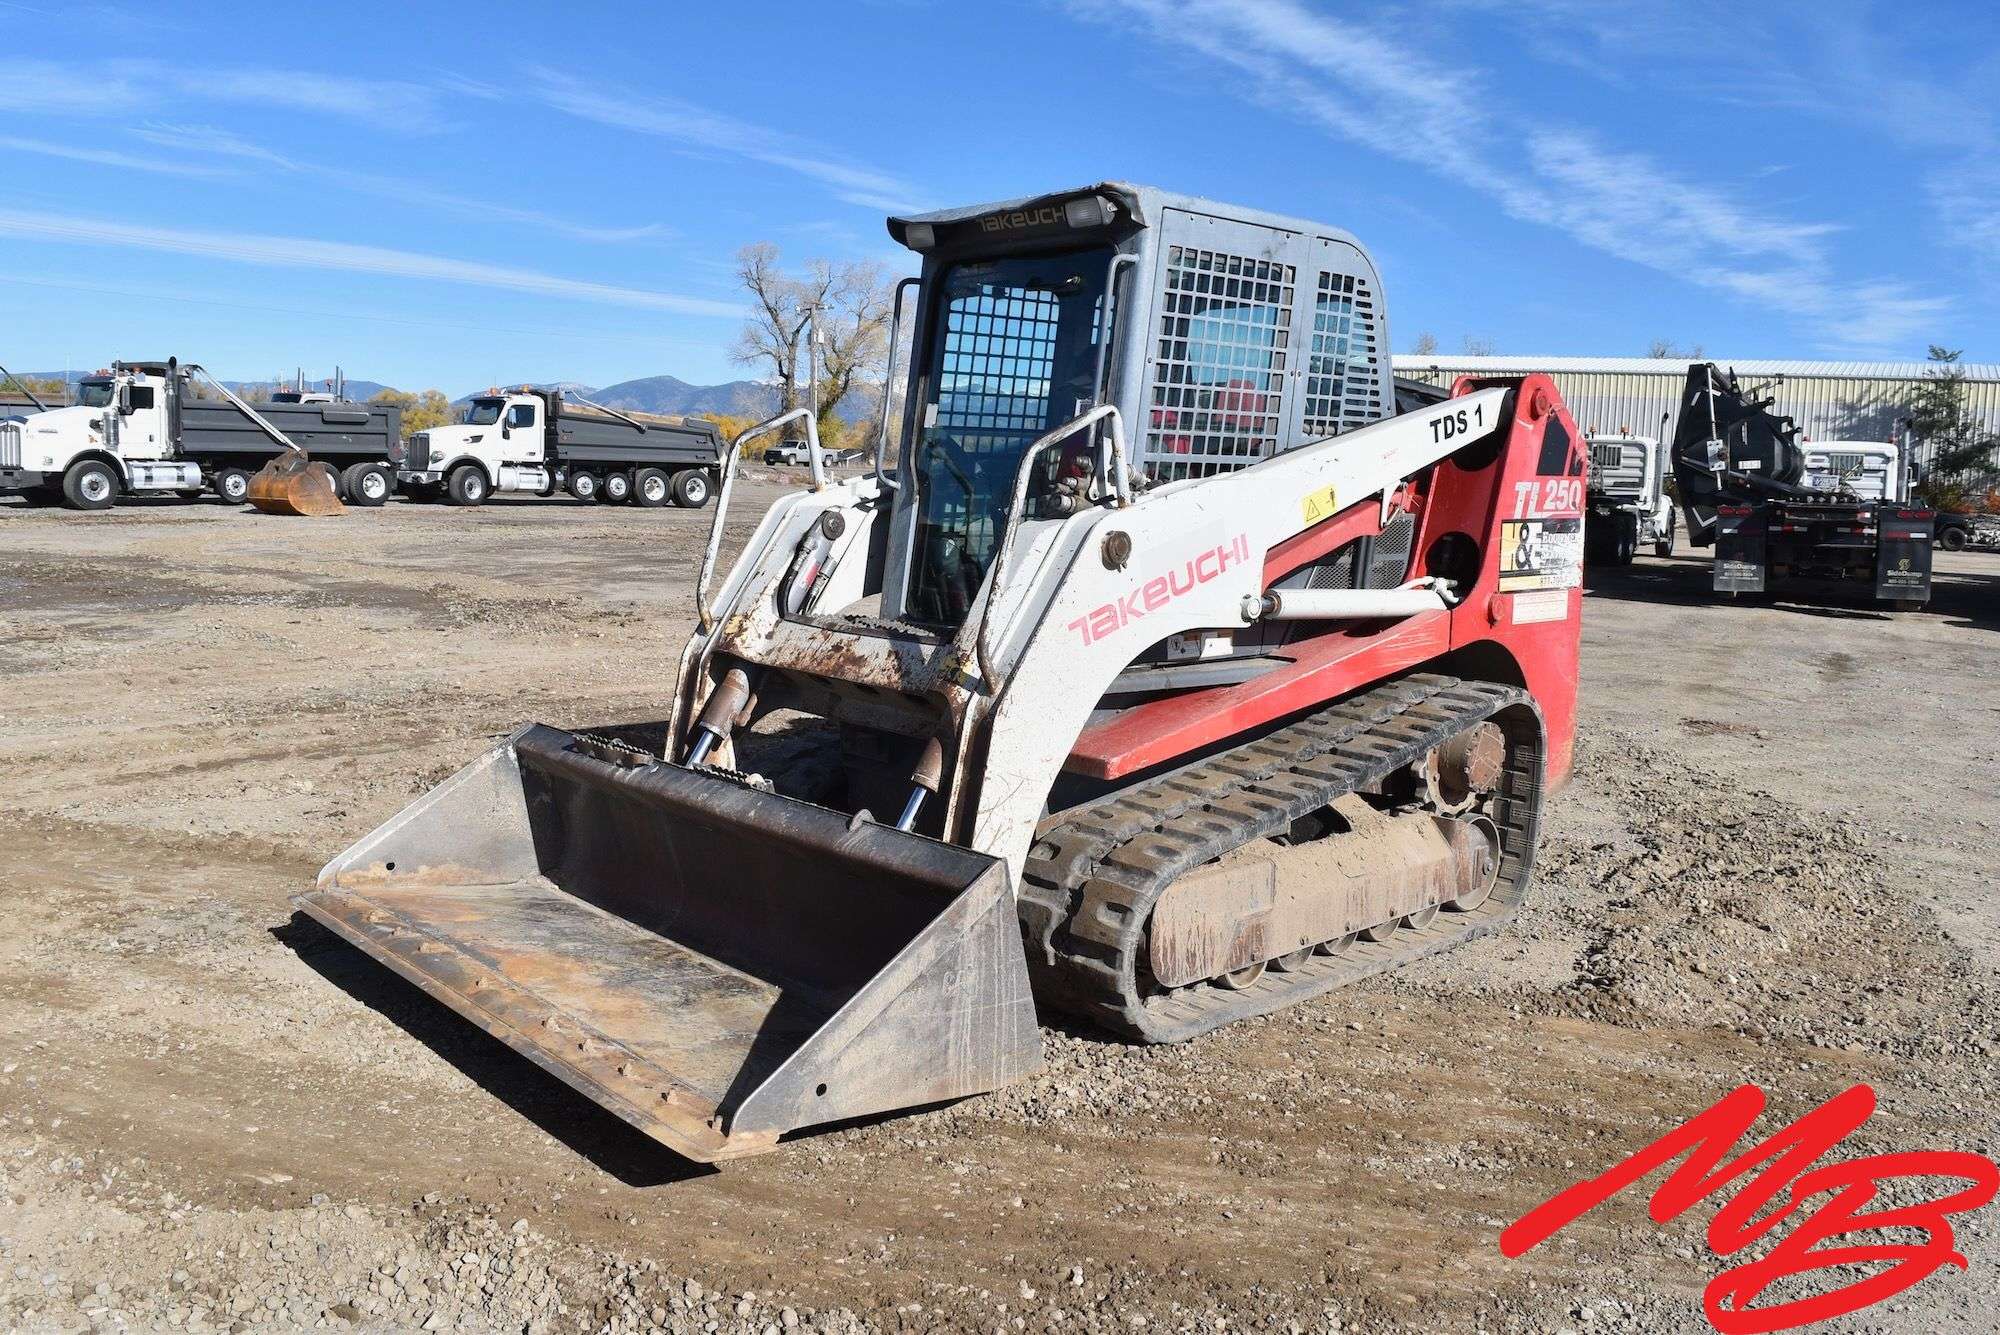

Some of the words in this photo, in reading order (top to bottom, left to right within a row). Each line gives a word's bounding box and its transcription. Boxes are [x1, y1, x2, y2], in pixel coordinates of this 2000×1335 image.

[977, 205, 1067, 232] TAKEUCH
[1429, 409, 1468, 443] TDS
[1474, 402, 1483, 427] 1
